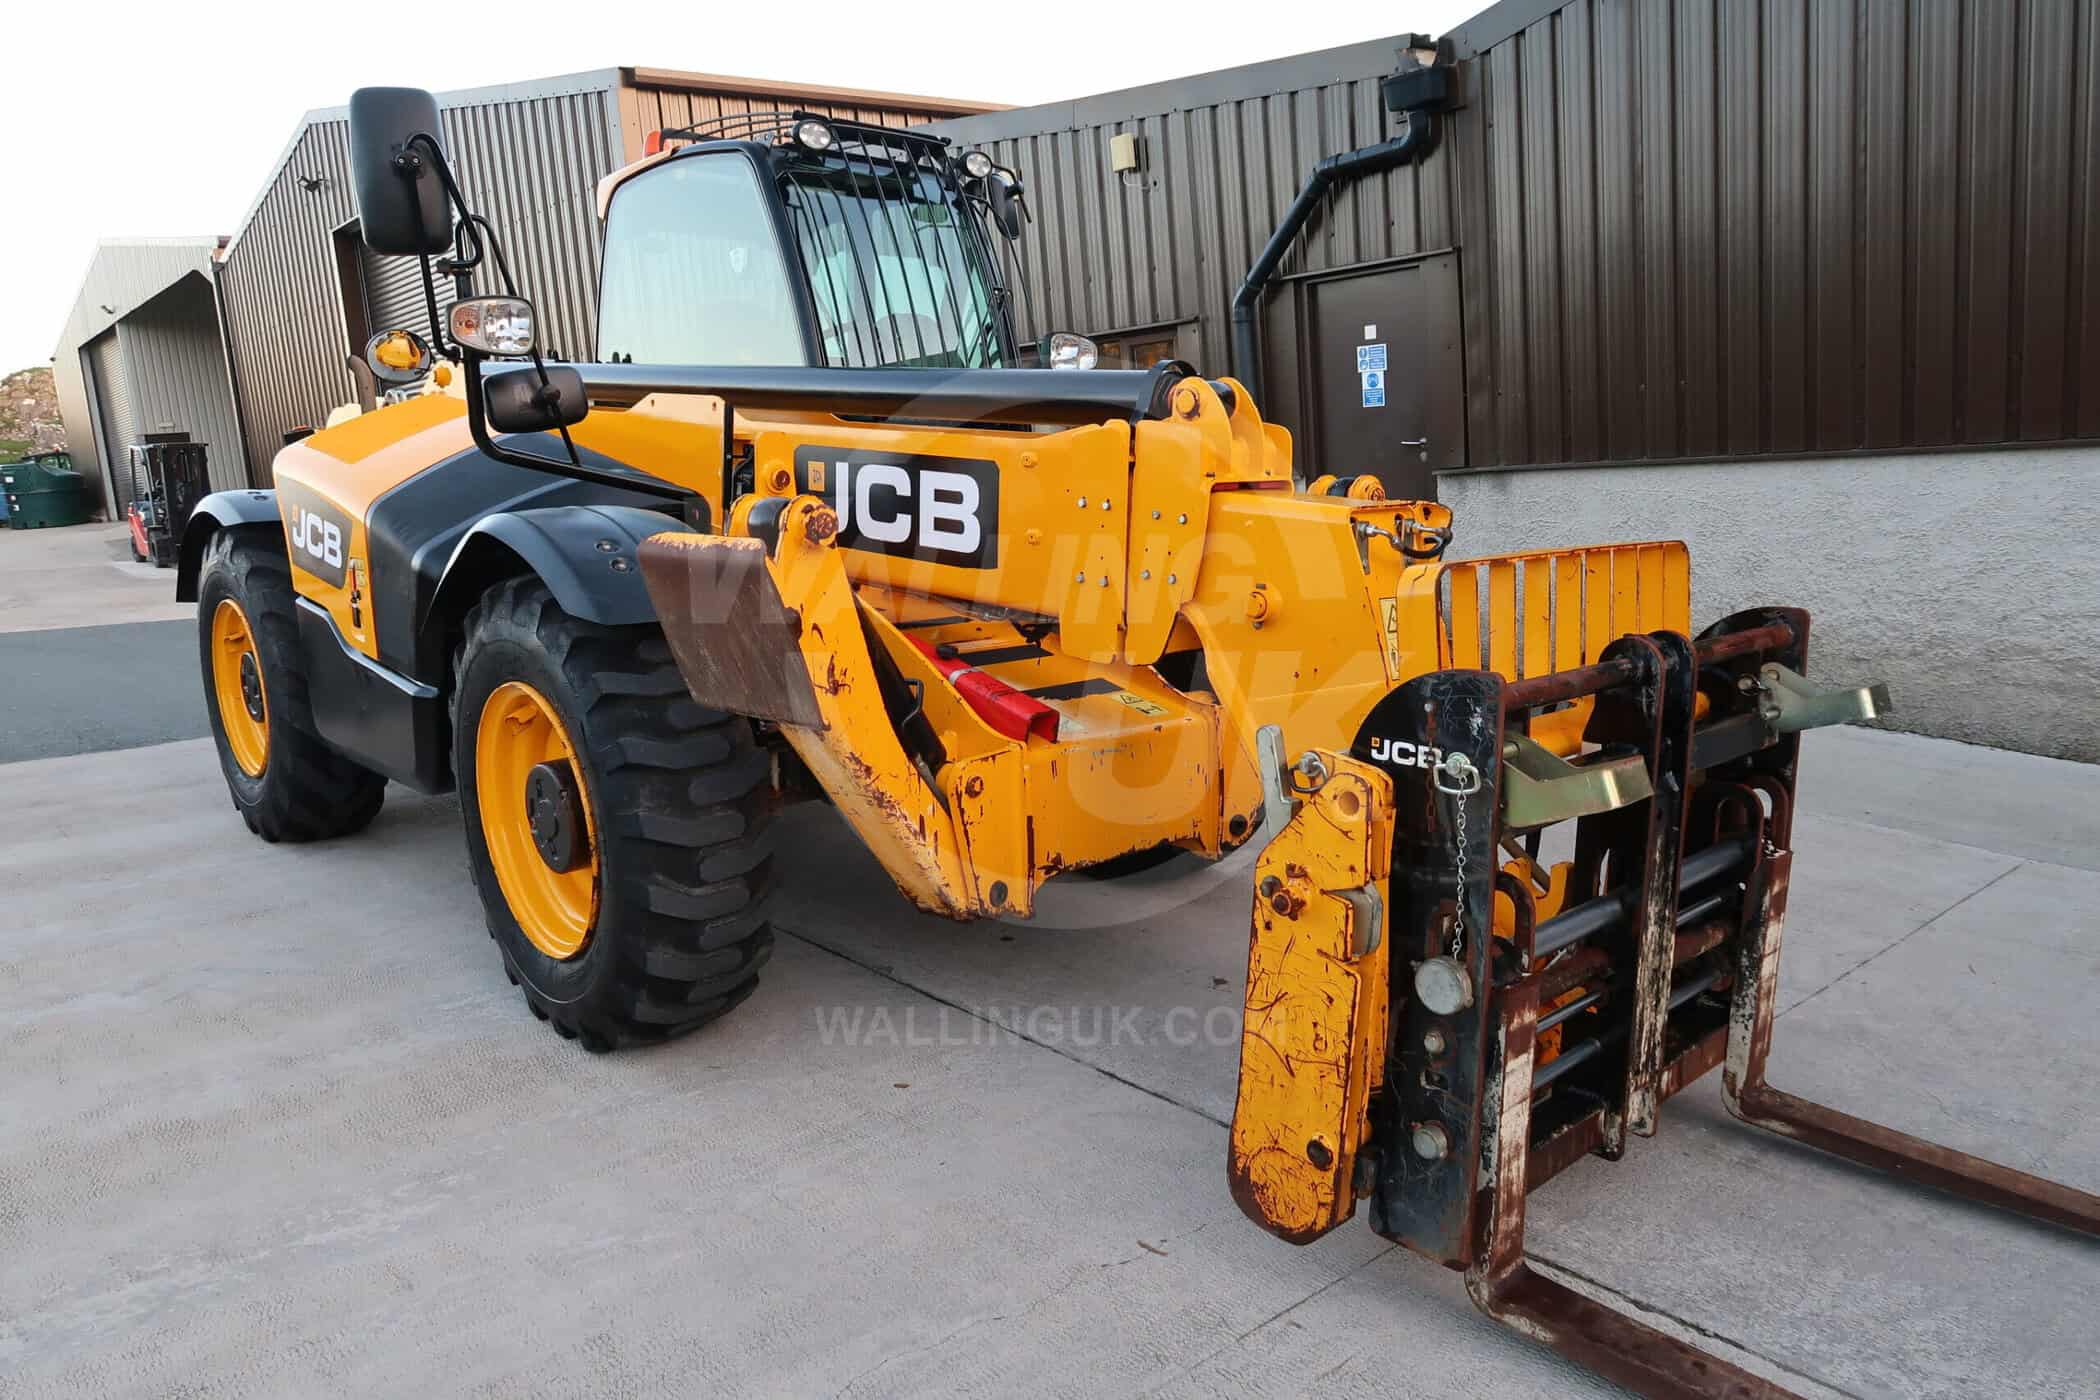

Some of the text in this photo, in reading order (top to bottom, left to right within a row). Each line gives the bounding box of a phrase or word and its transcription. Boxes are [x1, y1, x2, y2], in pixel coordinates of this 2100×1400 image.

[836, 461, 981, 554] JCB
[292, 508, 343, 569] JCB
[1371, 739, 1442, 769] JCB
